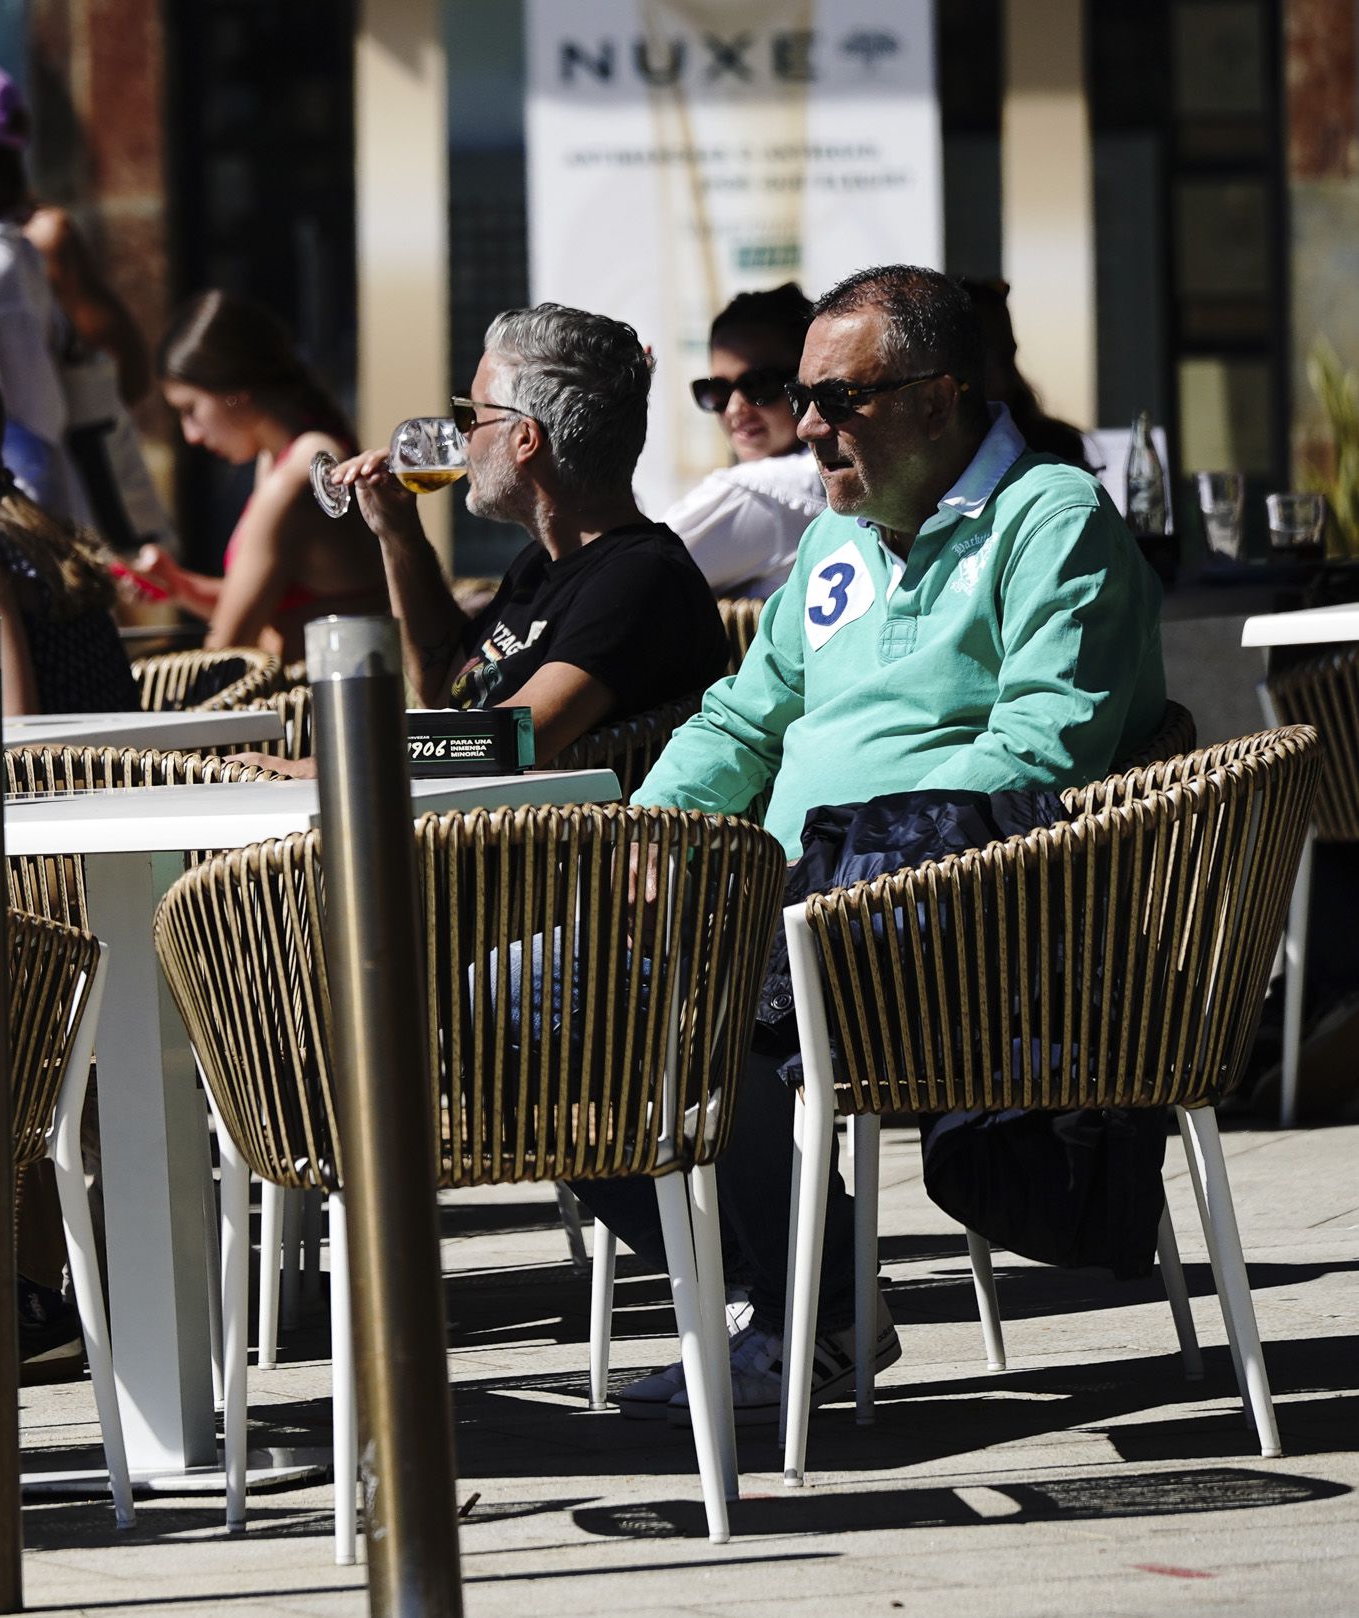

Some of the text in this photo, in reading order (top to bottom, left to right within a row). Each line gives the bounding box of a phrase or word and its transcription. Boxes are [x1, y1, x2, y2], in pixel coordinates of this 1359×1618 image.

[559, 30, 816, 87] NUXE
[808, 562, 855, 627] 3
[450, 750, 485, 758] MINORÍA
